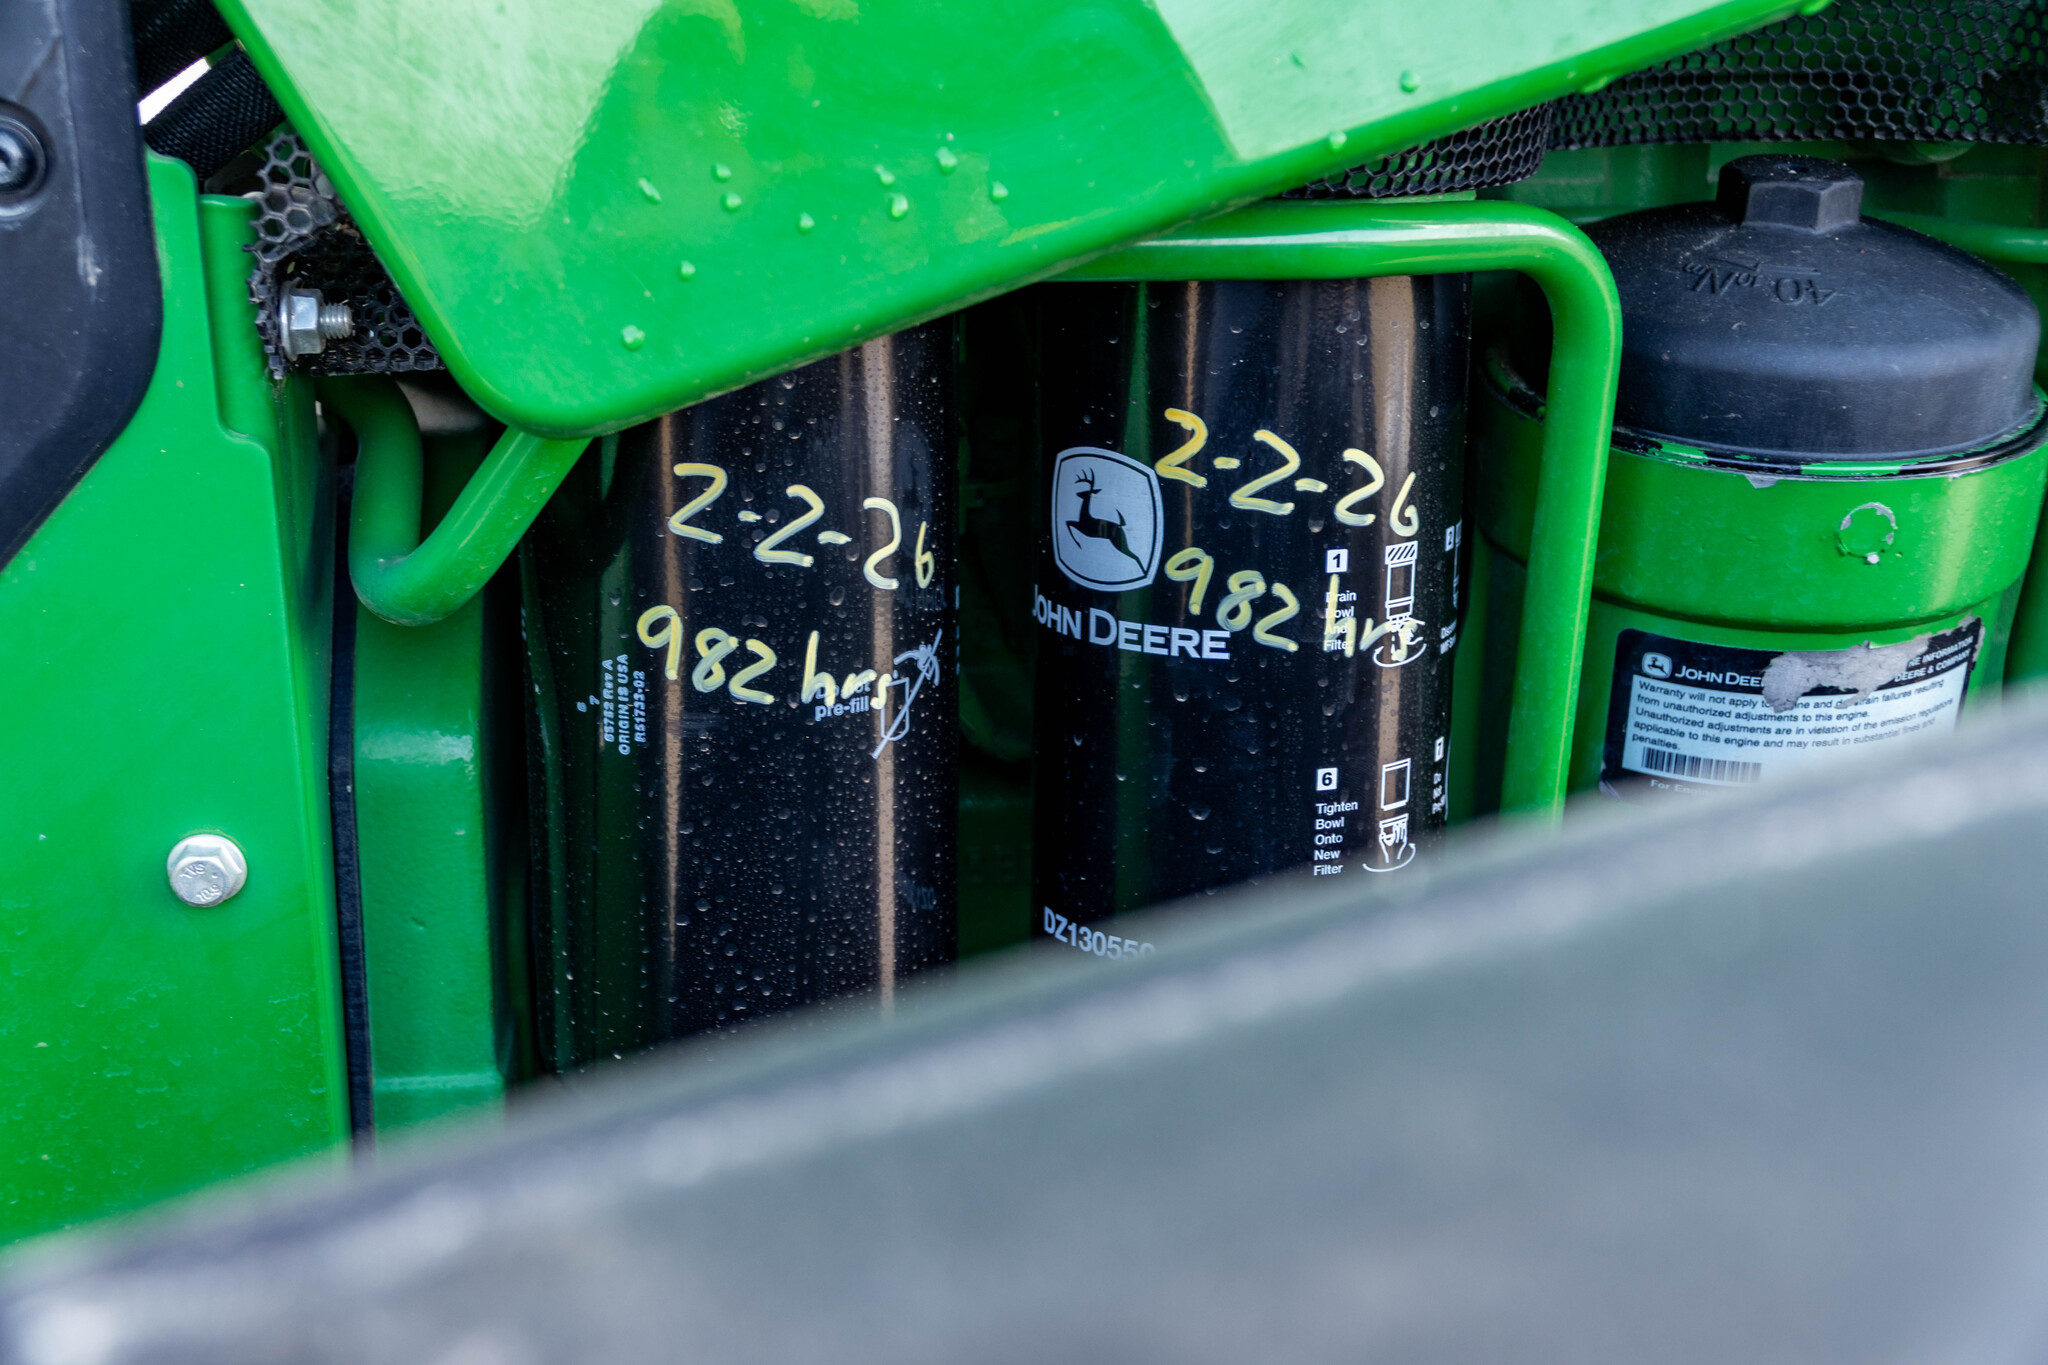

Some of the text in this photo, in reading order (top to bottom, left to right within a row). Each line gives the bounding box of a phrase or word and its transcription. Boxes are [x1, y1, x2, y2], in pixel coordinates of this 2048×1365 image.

[1154, 407, 1420, 537] 2-2-26
[667, 462, 935, 589] 2-2-26
[1165, 546, 1300, 652] 982
[1325, 606, 1355, 619] owl
[1032, 583, 1231, 661] JOHN DEERE
[601, 659, 614, 671] A
[636, 604, 777, 705] 982
[1674, 665, 1765, 687] JOHN DEE
[616, 654, 631, 756] ORIGIN IS USA
[1637, 693, 1869, 722] from unauthorized adjustments to this engine.
[1639, 681, 1686, 700] Warranty
[1689, 692, 1706, 702] will
[1709, 695, 1726, 705] not
[1729, 698, 1758, 709] apply
[1813, 700, 1833, 709] and
[1882, 689, 1912, 702] failures
[1914, 679, 1944, 695] resulting
[814, 695, 870, 722] pre-fill
[1636, 706, 1704, 728] Unauthorized
[1707, 721, 1772, 735] adjustments
[1775, 727, 1792, 735] are
[1795, 725, 1805, 734] in
[1808, 722, 1849, 735] violation
[1851, 723, 1862, 732] of
[1863, 721, 1878, 730] the
[1880, 712, 1917, 727] emission
[1632, 733, 1681, 751] penalties.
[1633, 721, 1686, 739] applicable
[1689, 732, 1699, 740] to
[1702, 733, 1721, 744] this
[1724, 737, 1760, 748] engine
[1763, 739, 1784, 748] and
[1787, 740, 1808, 750] may
[1812, 737, 1840, 747] result
[1841, 737, 1851, 745] in
[1650, 779, 1671, 791] For
[1315, 801, 1359, 816] Tighten
[1315, 817, 1345, 830] Bowl
[1314, 833, 1344, 846] Onto
[1314, 848, 1342, 861] New
[1313, 864, 1344, 876] Filter
[1043, 906, 1156, 961] DZ13055
